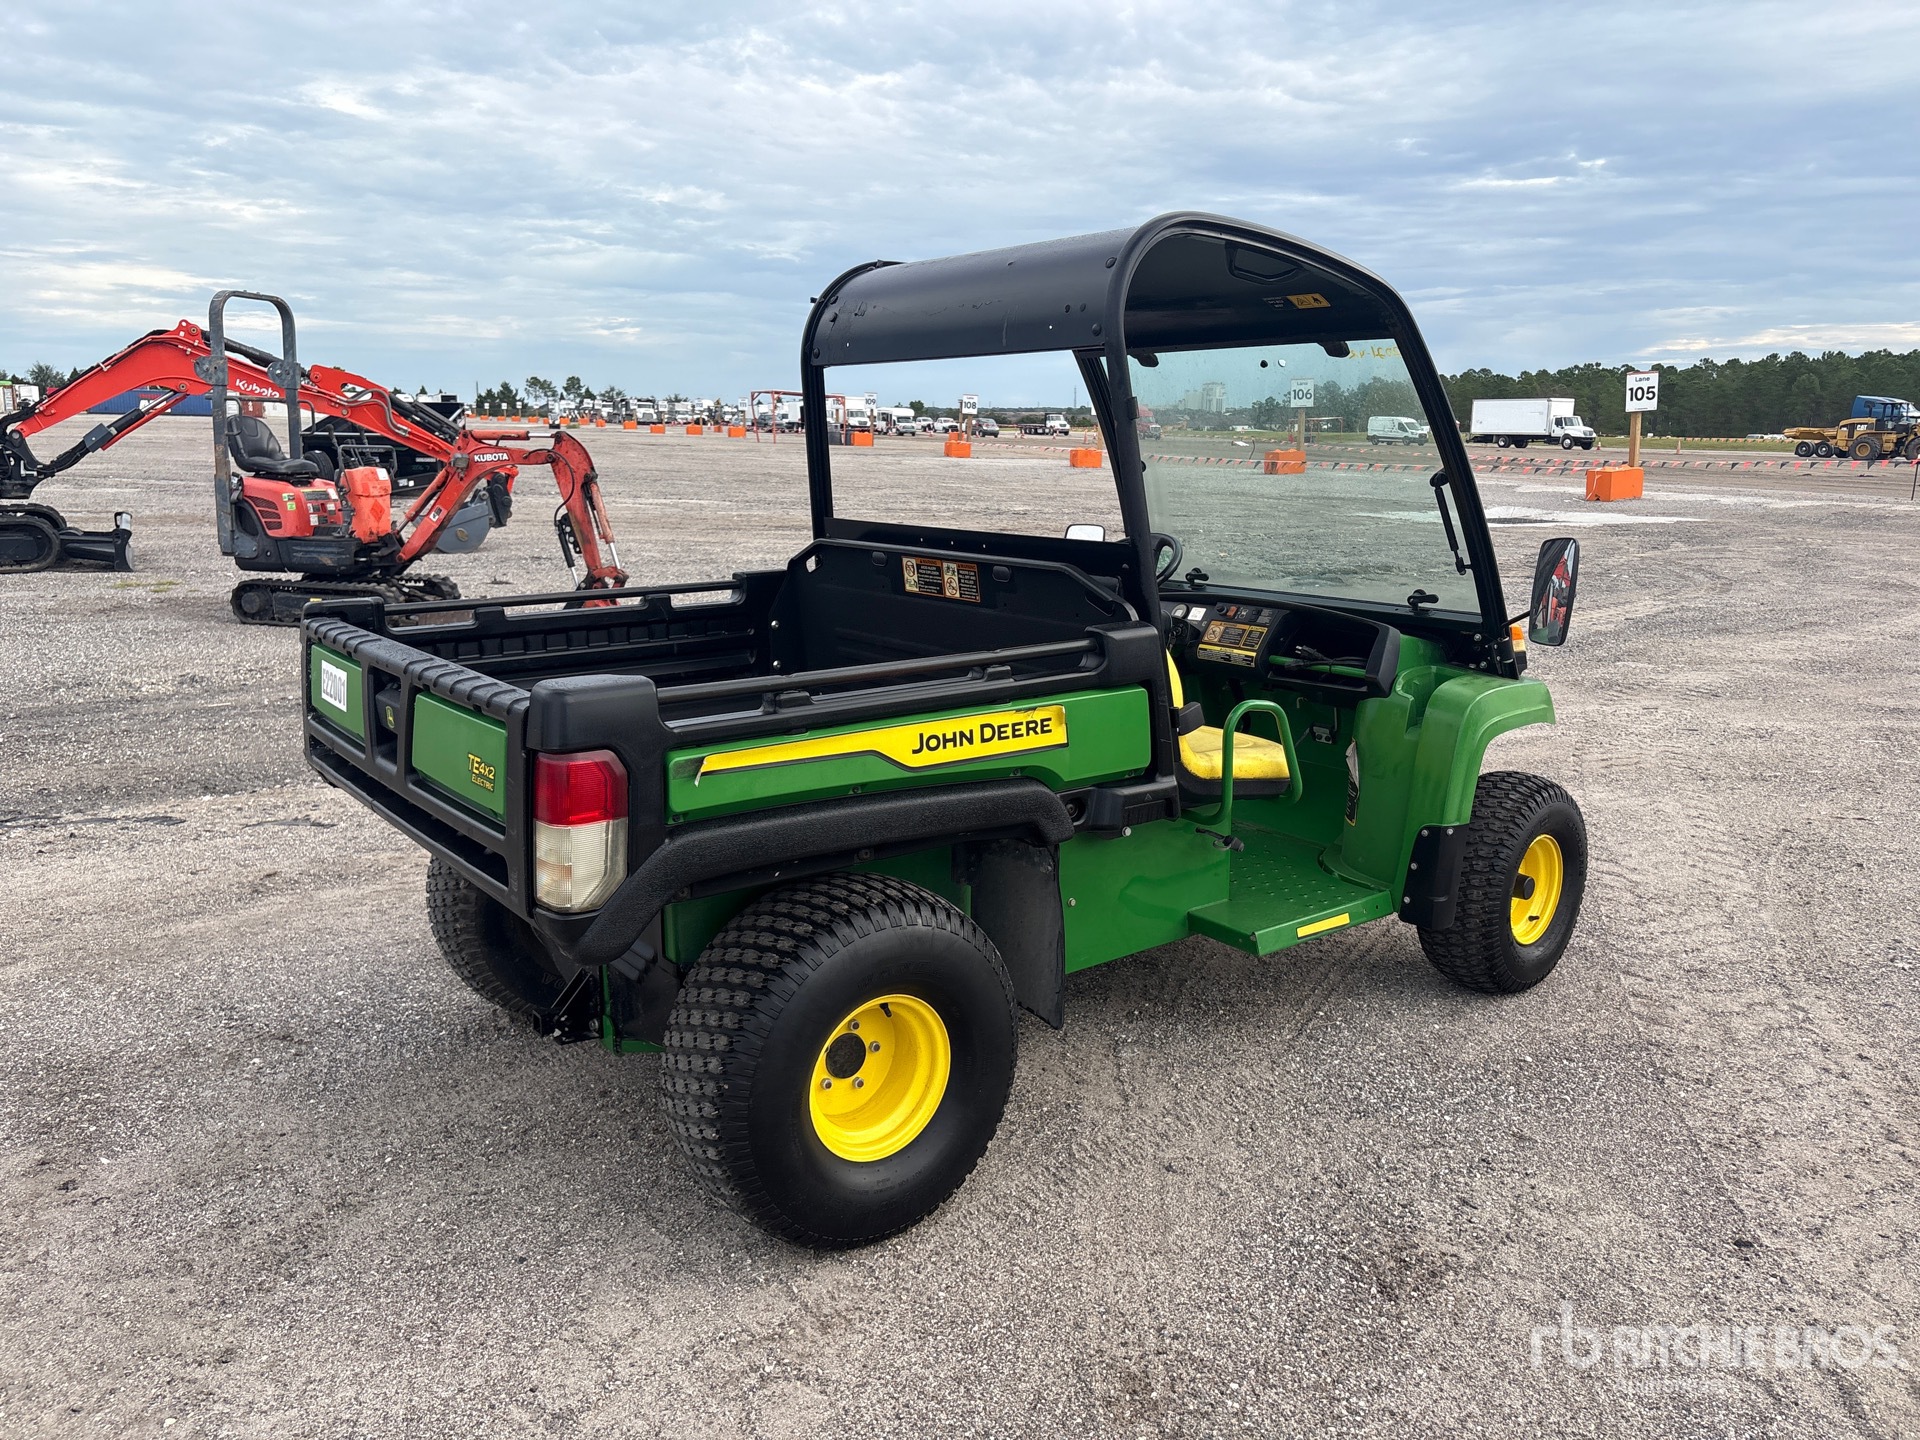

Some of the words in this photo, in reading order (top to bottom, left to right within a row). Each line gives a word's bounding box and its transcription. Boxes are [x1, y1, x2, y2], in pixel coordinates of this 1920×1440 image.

[235, 378, 280, 398] Kubota
[1292, 388, 1313, 400] 106
[1628, 385, 1656, 402] 105
[963, 401, 977, 410] 108
[474, 453, 509, 462] KUBOTA
[322, 668, 346, 706] E22001
[911, 729, 974, 754] JOHN
[980, 717, 1052, 743] DEERE
[471, 773, 494, 792] ELECTRIC
